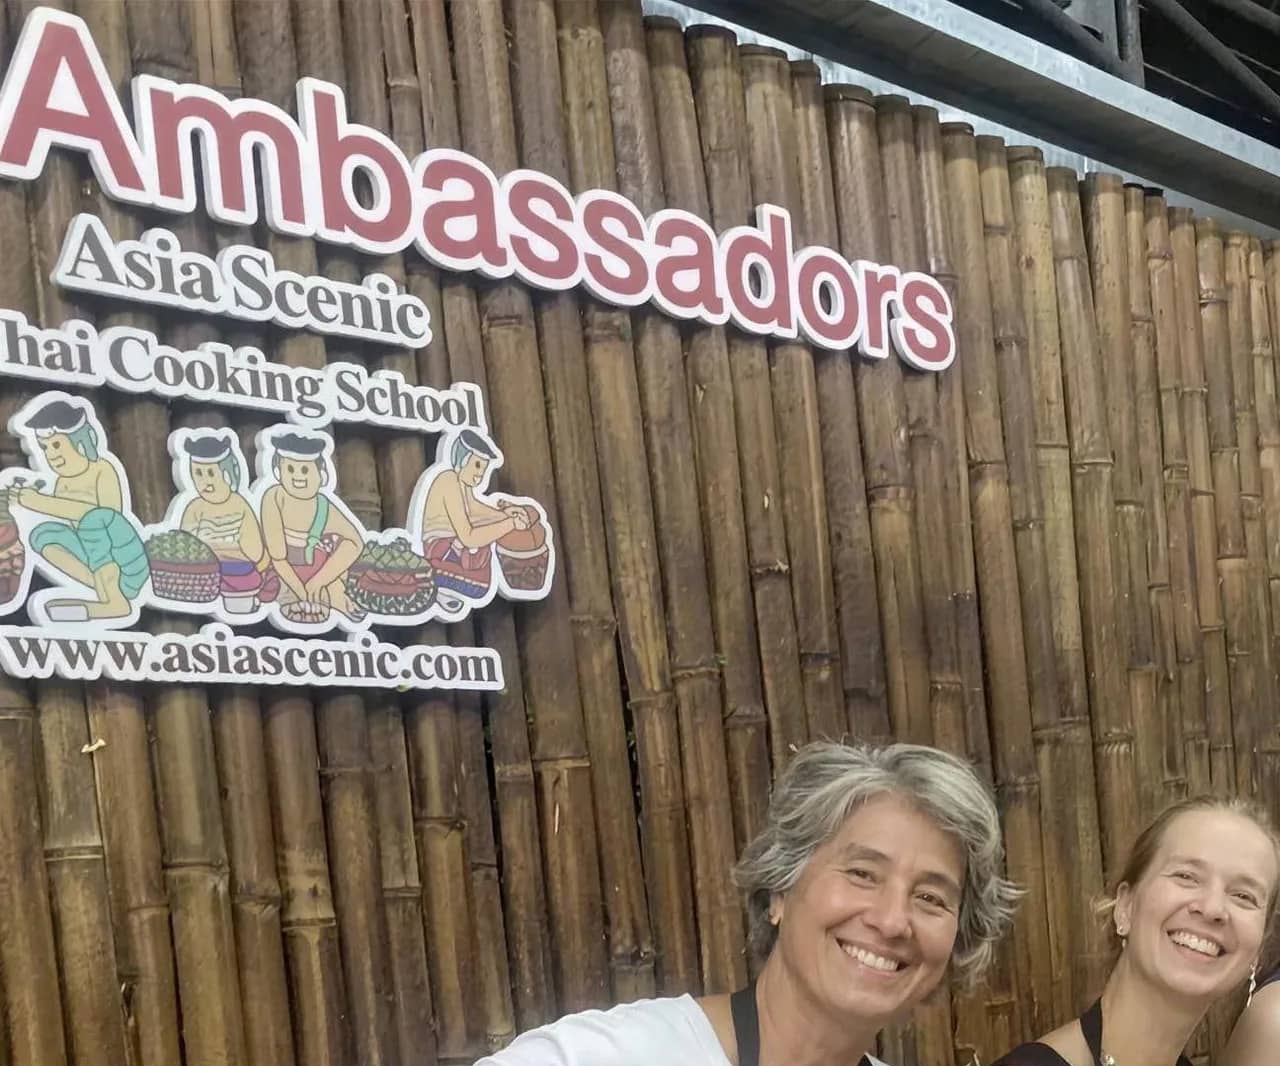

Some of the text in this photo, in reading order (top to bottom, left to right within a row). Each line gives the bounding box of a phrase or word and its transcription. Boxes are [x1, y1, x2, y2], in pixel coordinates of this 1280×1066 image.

[0, 20, 953, 364] Ambassadors
[65, 223, 426, 339] Asia Scenic
[0, 318, 480, 427] hai Cooking School
[6, 631, 499, 682] www.asiascenic.com
